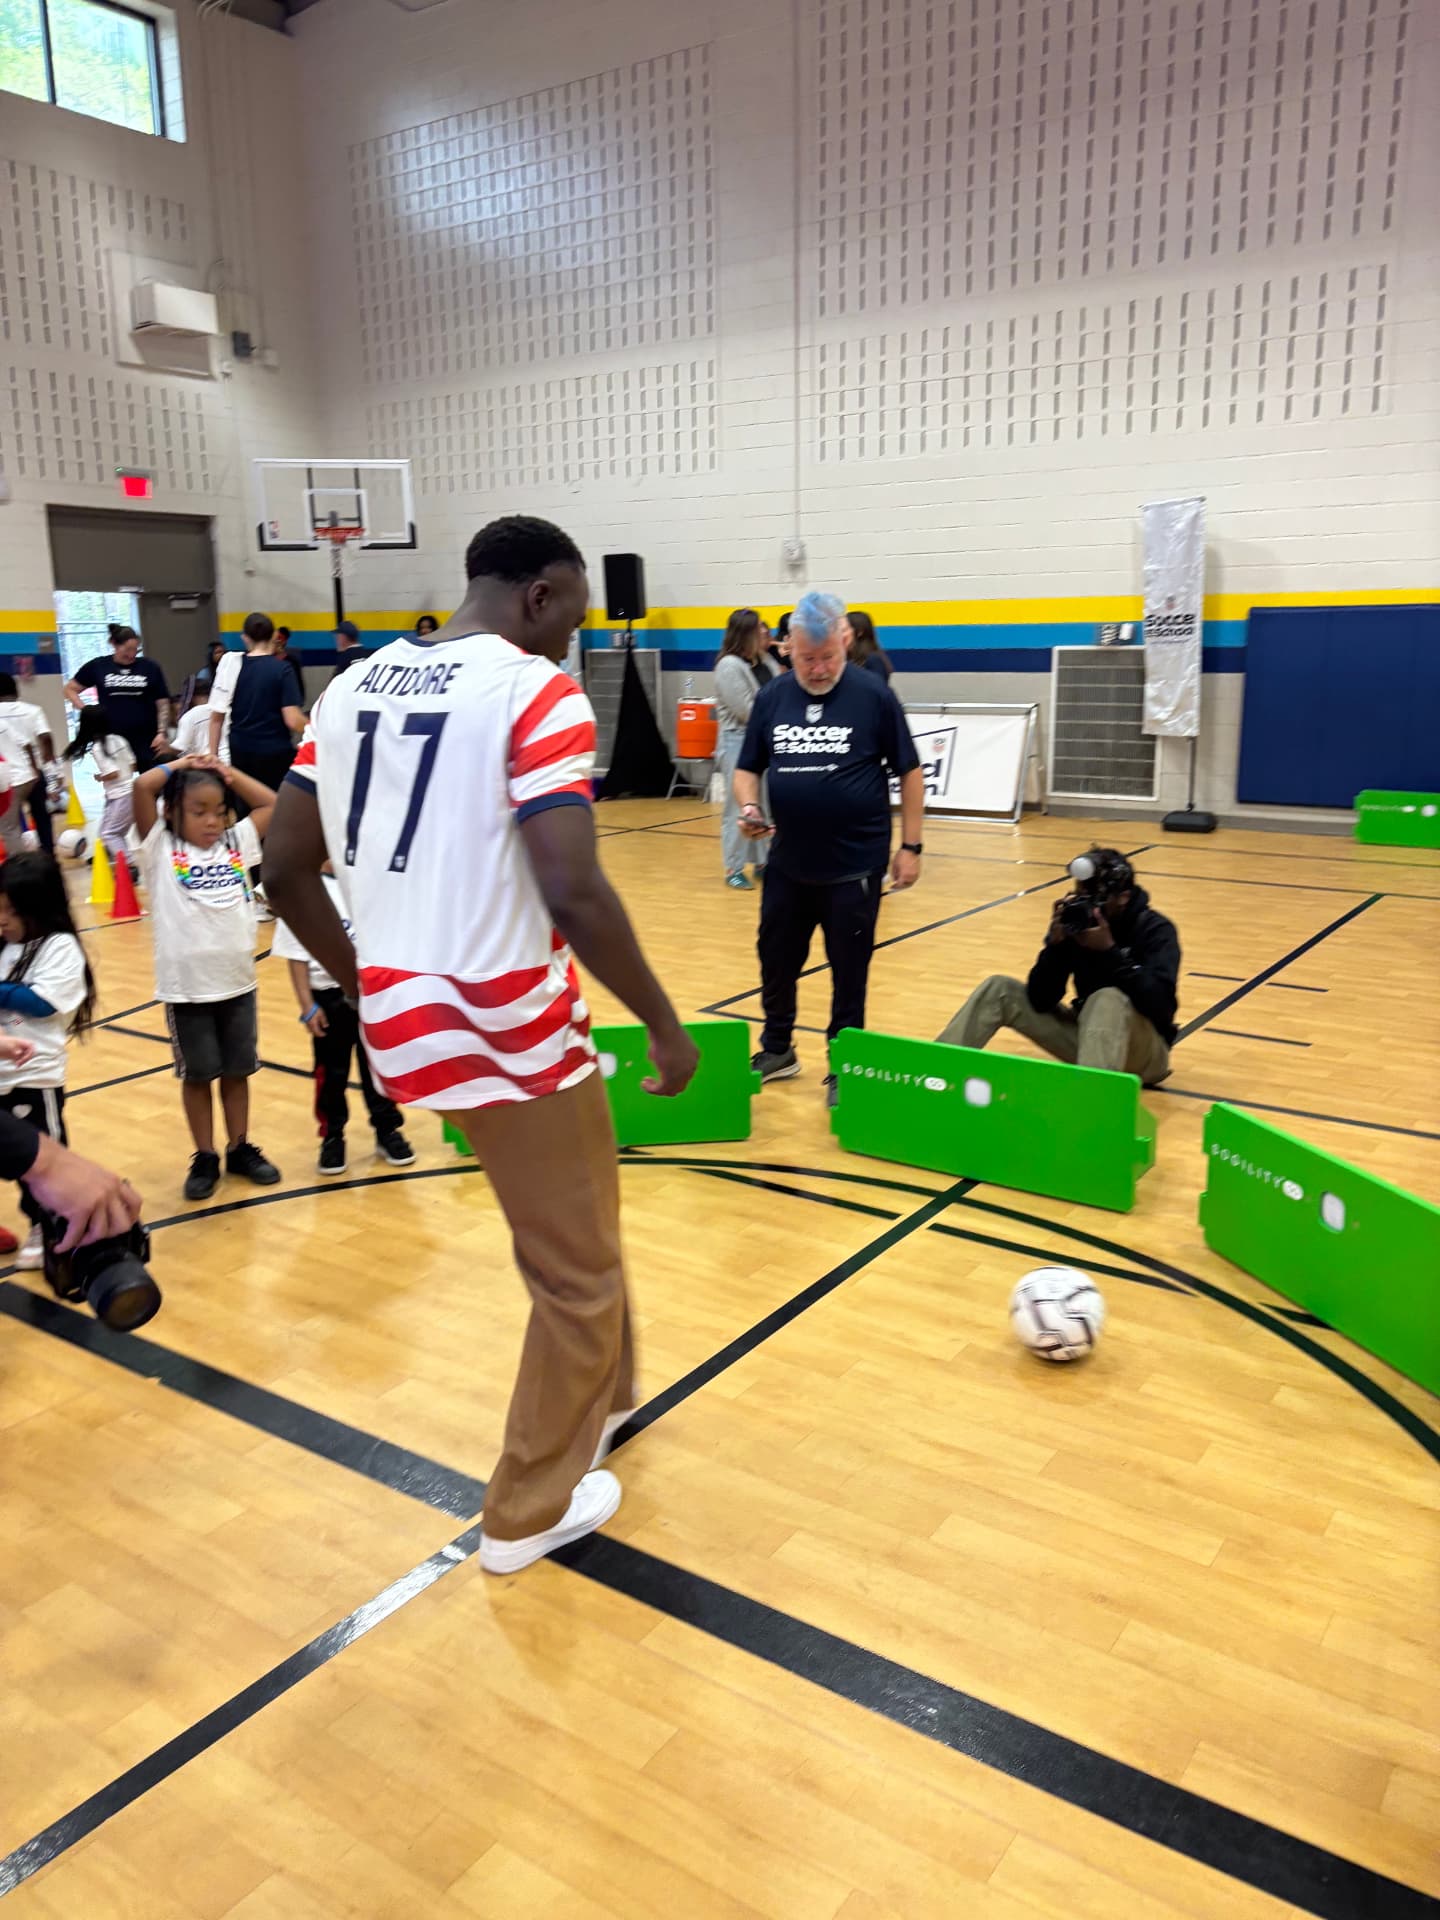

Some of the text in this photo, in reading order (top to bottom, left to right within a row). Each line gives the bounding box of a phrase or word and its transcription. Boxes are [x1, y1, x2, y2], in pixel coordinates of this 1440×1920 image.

[355, 662, 464, 696] ALTIDORE
[773, 724, 853, 742] Soccer
[786, 741, 851, 754] Schools
[345, 709, 452, 872] 17
[842, 1062, 927, 1088] SOGILITY
[1211, 1143, 1286, 1188] SOGILITY
